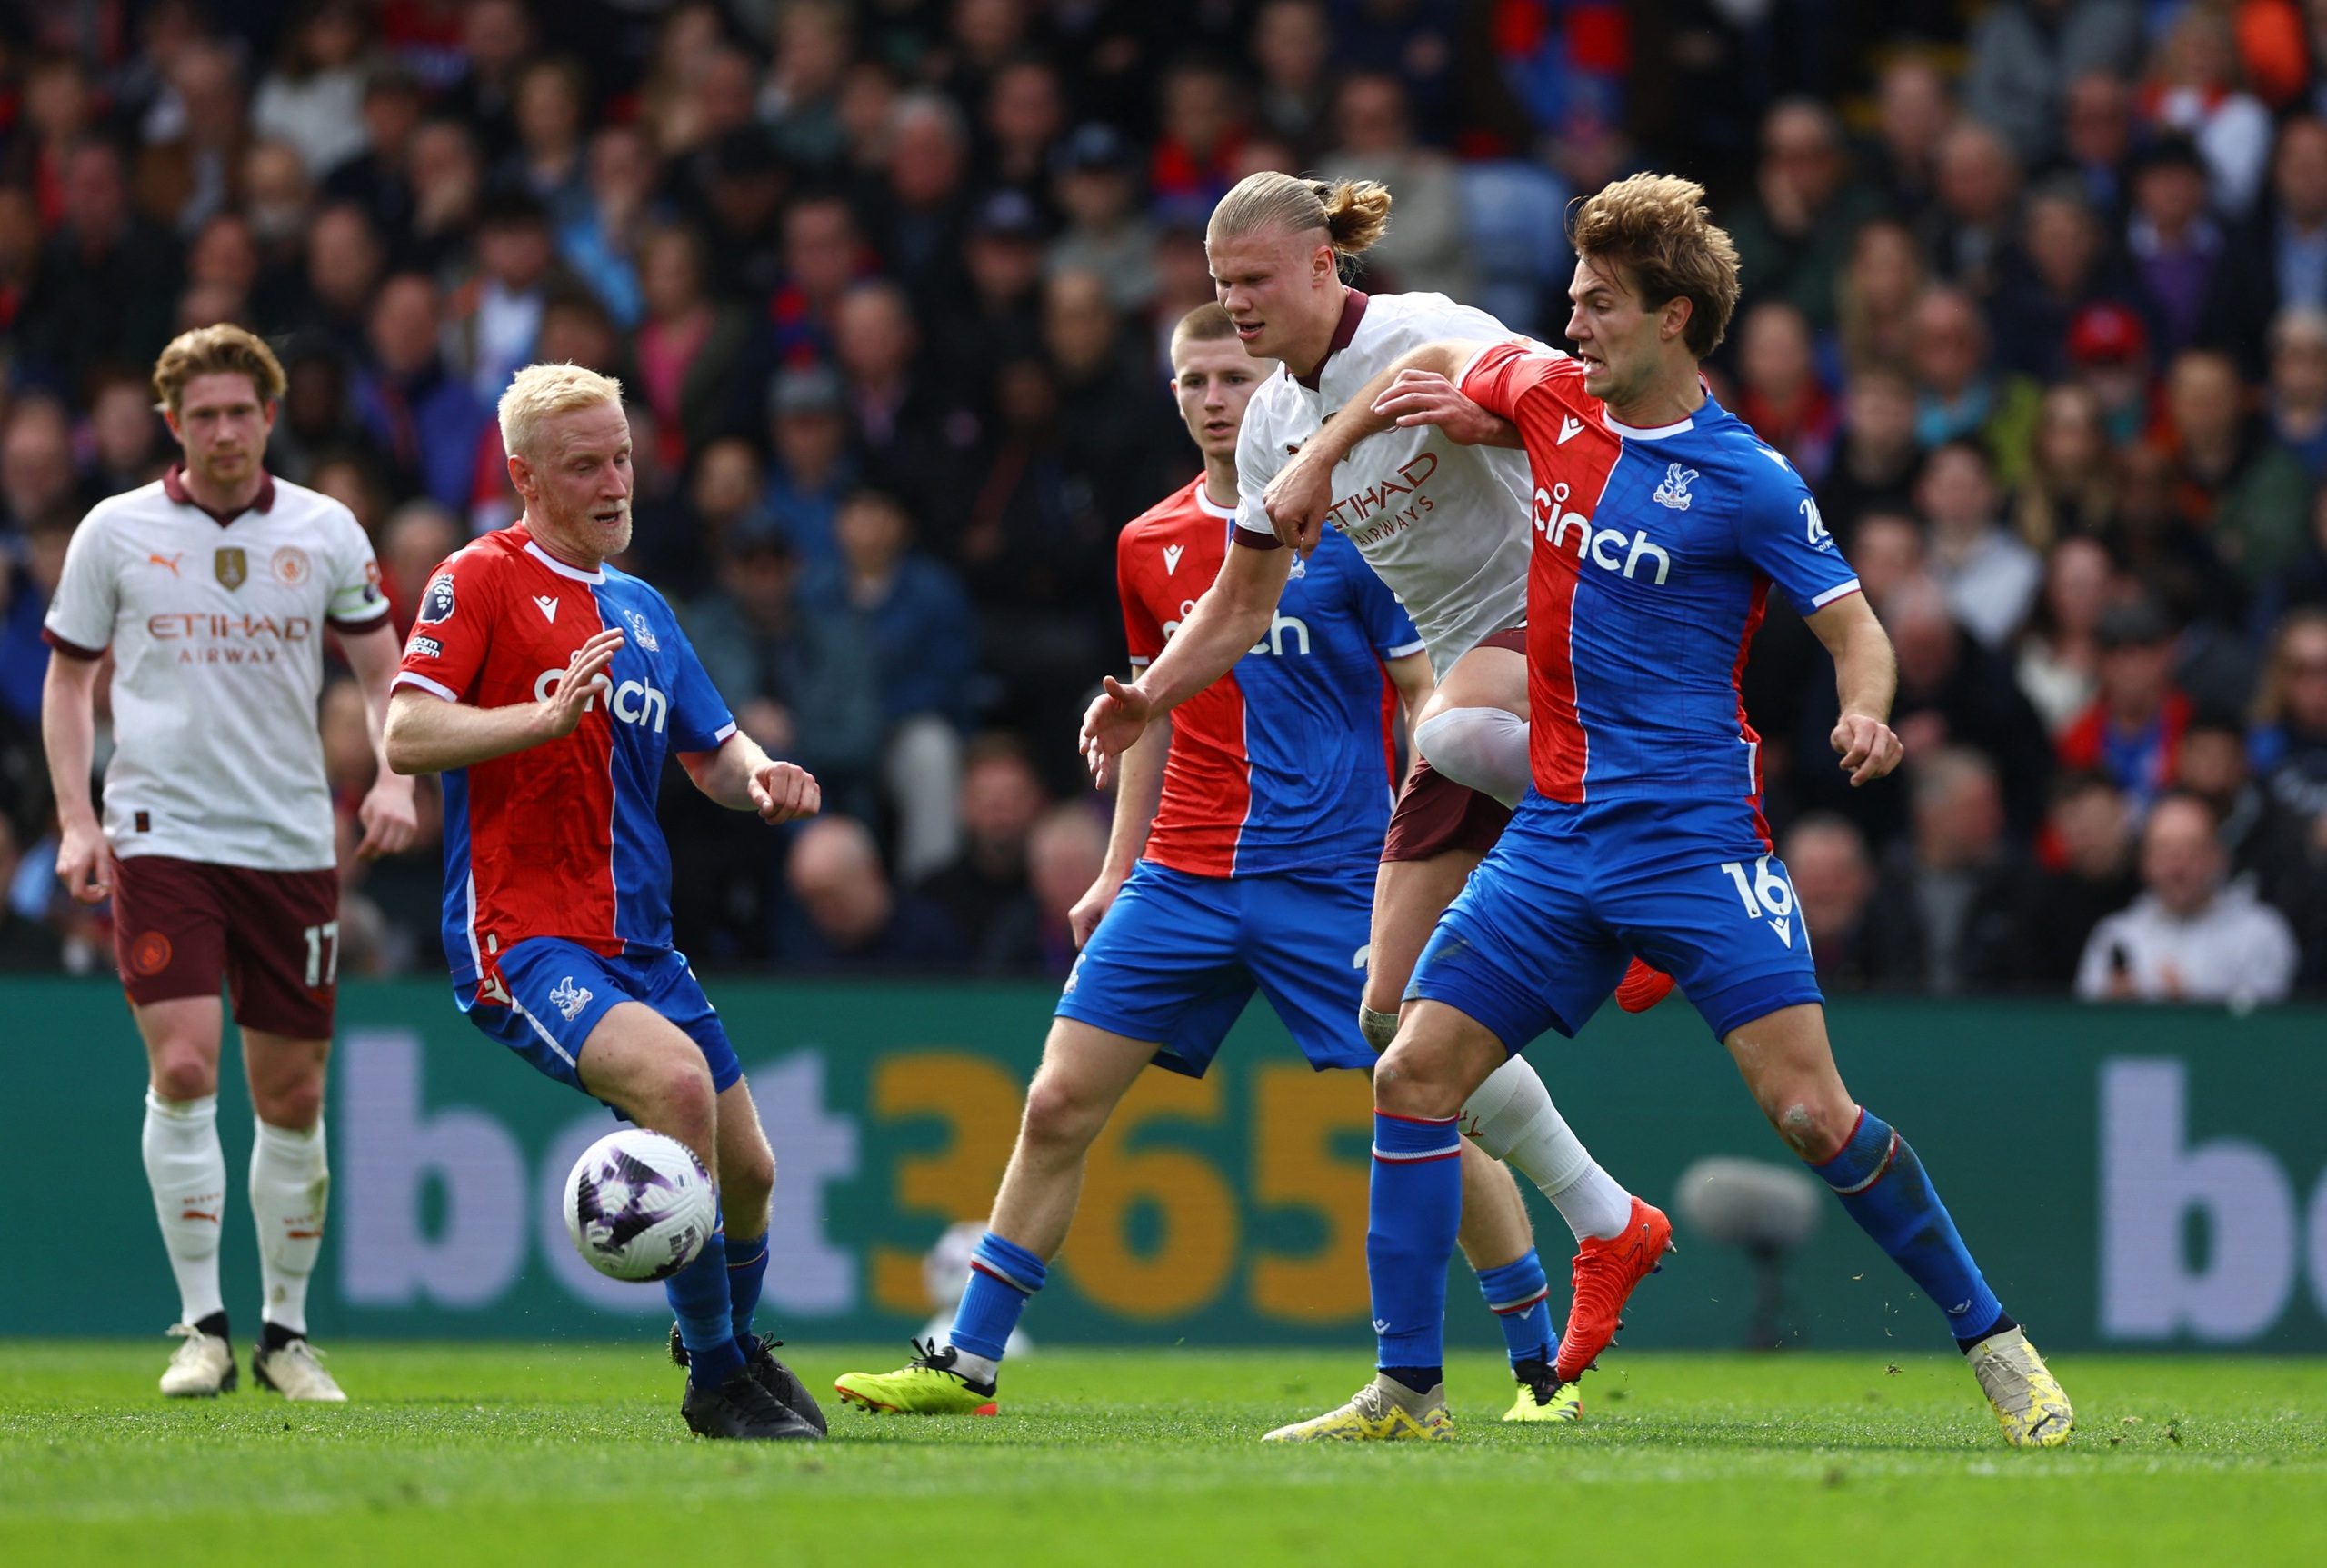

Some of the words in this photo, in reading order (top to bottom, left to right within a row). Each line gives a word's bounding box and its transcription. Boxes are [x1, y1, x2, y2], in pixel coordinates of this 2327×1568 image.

[1354, 495, 1434, 547] AIRWAYS
[1534, 482, 1670, 585] cinch
[148, 613, 311, 642] ETIHAD
[178, 646, 276, 664] AIRWAY
[412, 637, 438, 649] oom
[534, 649, 667, 734] cnch
[1721, 855, 1793, 919] 16
[305, 921, 339, 987] 17
